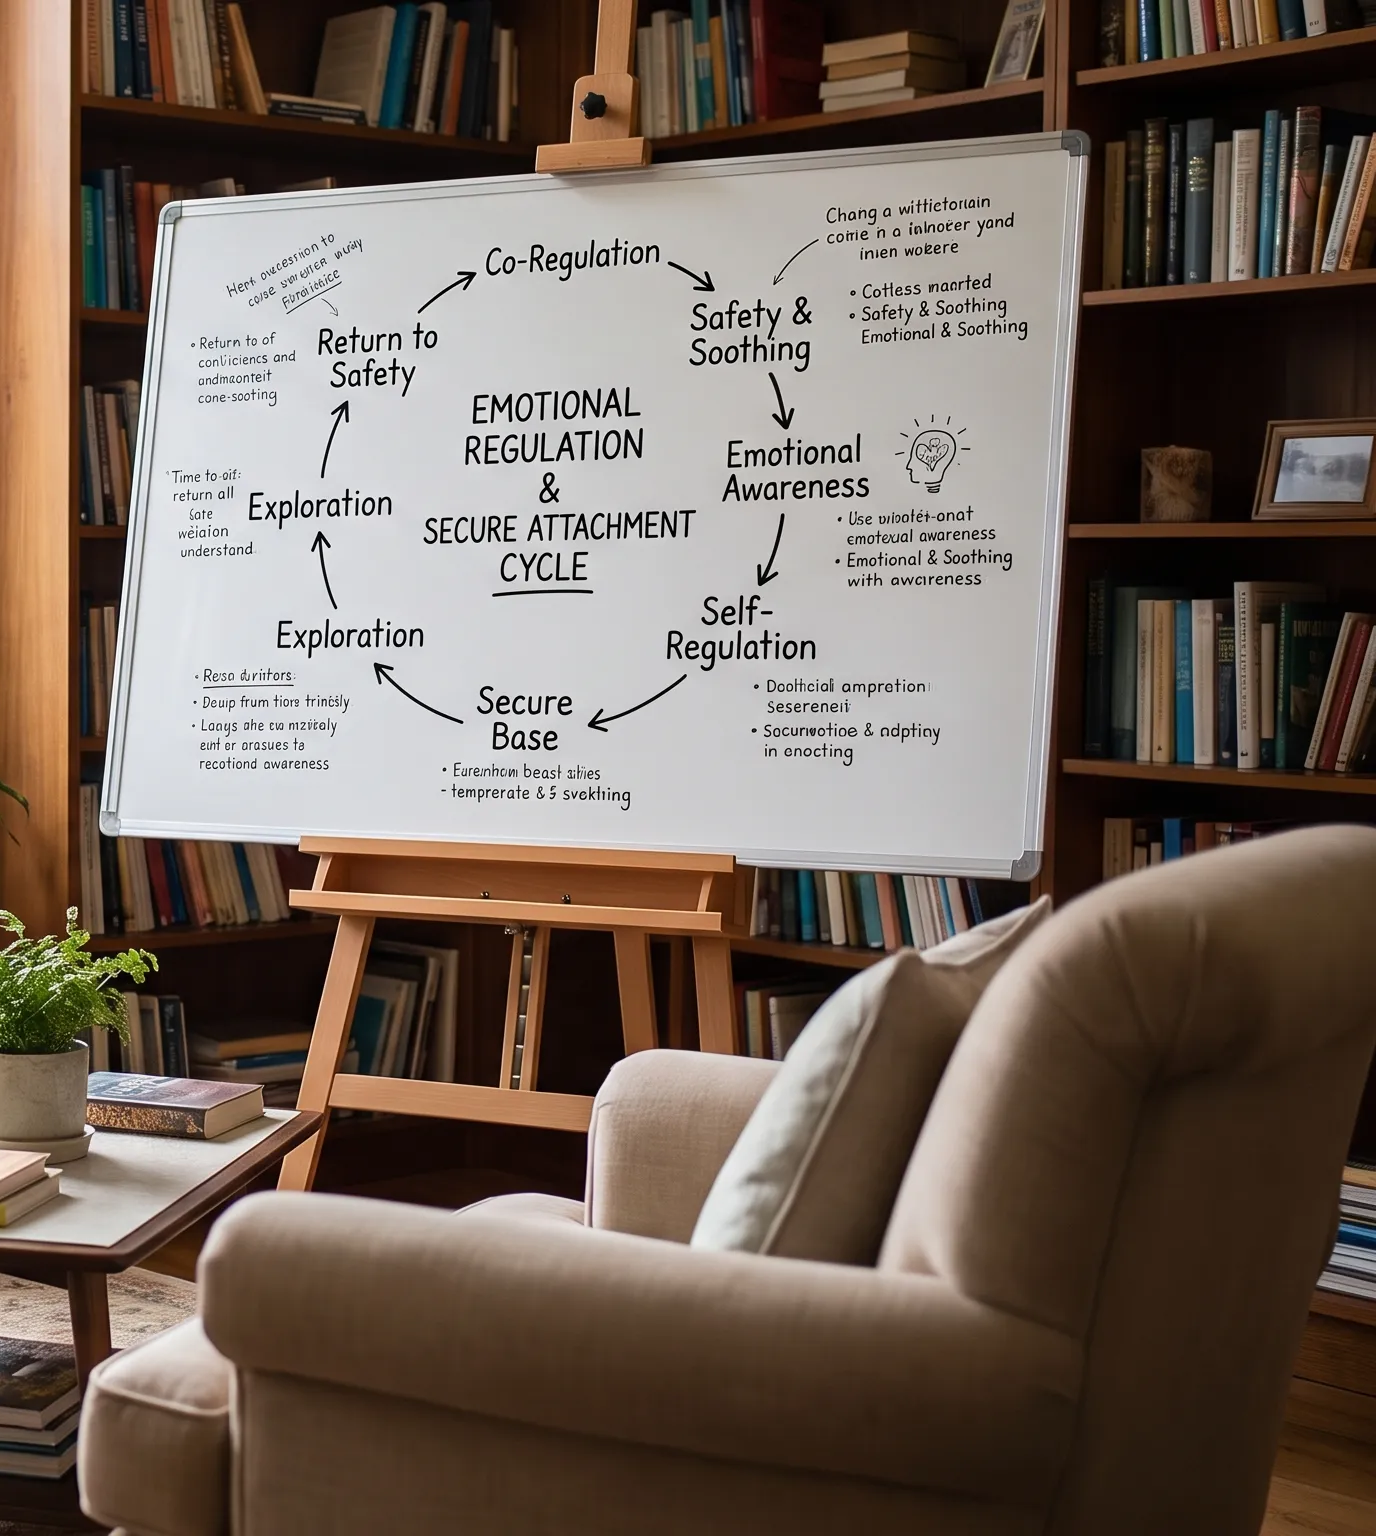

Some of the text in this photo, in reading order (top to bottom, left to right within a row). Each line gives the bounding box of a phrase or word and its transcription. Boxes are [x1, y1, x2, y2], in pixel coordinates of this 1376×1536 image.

[882, 207, 892, 218] a
[320, 233, 335, 247] to
[892, 227, 902, 238] a
[485, 237, 660, 282] Co-Regulation
[689, 295, 813, 342] Safety &
[861, 296, 1007, 327] Safety & Soothing
[199, 331, 277, 350] Return to of
[317, 321, 439, 356] Return to
[861, 318, 1028, 345] Emotional & Soothing
[272, 349, 296, 363] and
[688, 333, 811, 373] Soothing
[329, 357, 417, 398] Safety
[471, 386, 642, 425] EMOTIONAL
[464, 427, 644, 466] REGULATION
[726, 432, 862, 469] Emotional
[171, 469, 201, 484] Time
[538, 471, 561, 504] &
[721, 473, 870, 503] Awareness
[173, 485, 234, 502] return all
[248, 487, 393, 531] Exploration
[422, 509, 697, 545] SECURE ATTACHMENT
[848, 510, 873, 526] Use
[180, 540, 253, 558] understand
[919, 528, 997, 543] awareness
[499, 551, 589, 583] CYCLE
[846, 548, 1013, 572] Emotional & Soothing
[847, 572, 883, 588] with
[700, 594, 774, 627] Self-
[276, 617, 424, 660] Exploration
[666, 629, 817, 672] Regulation
[476, 685, 574, 717] Secure
[491, 721, 559, 752] Base
[863, 722, 875, 737] &
[764, 743, 778, 758] in
[536, 785, 546, 800] &
